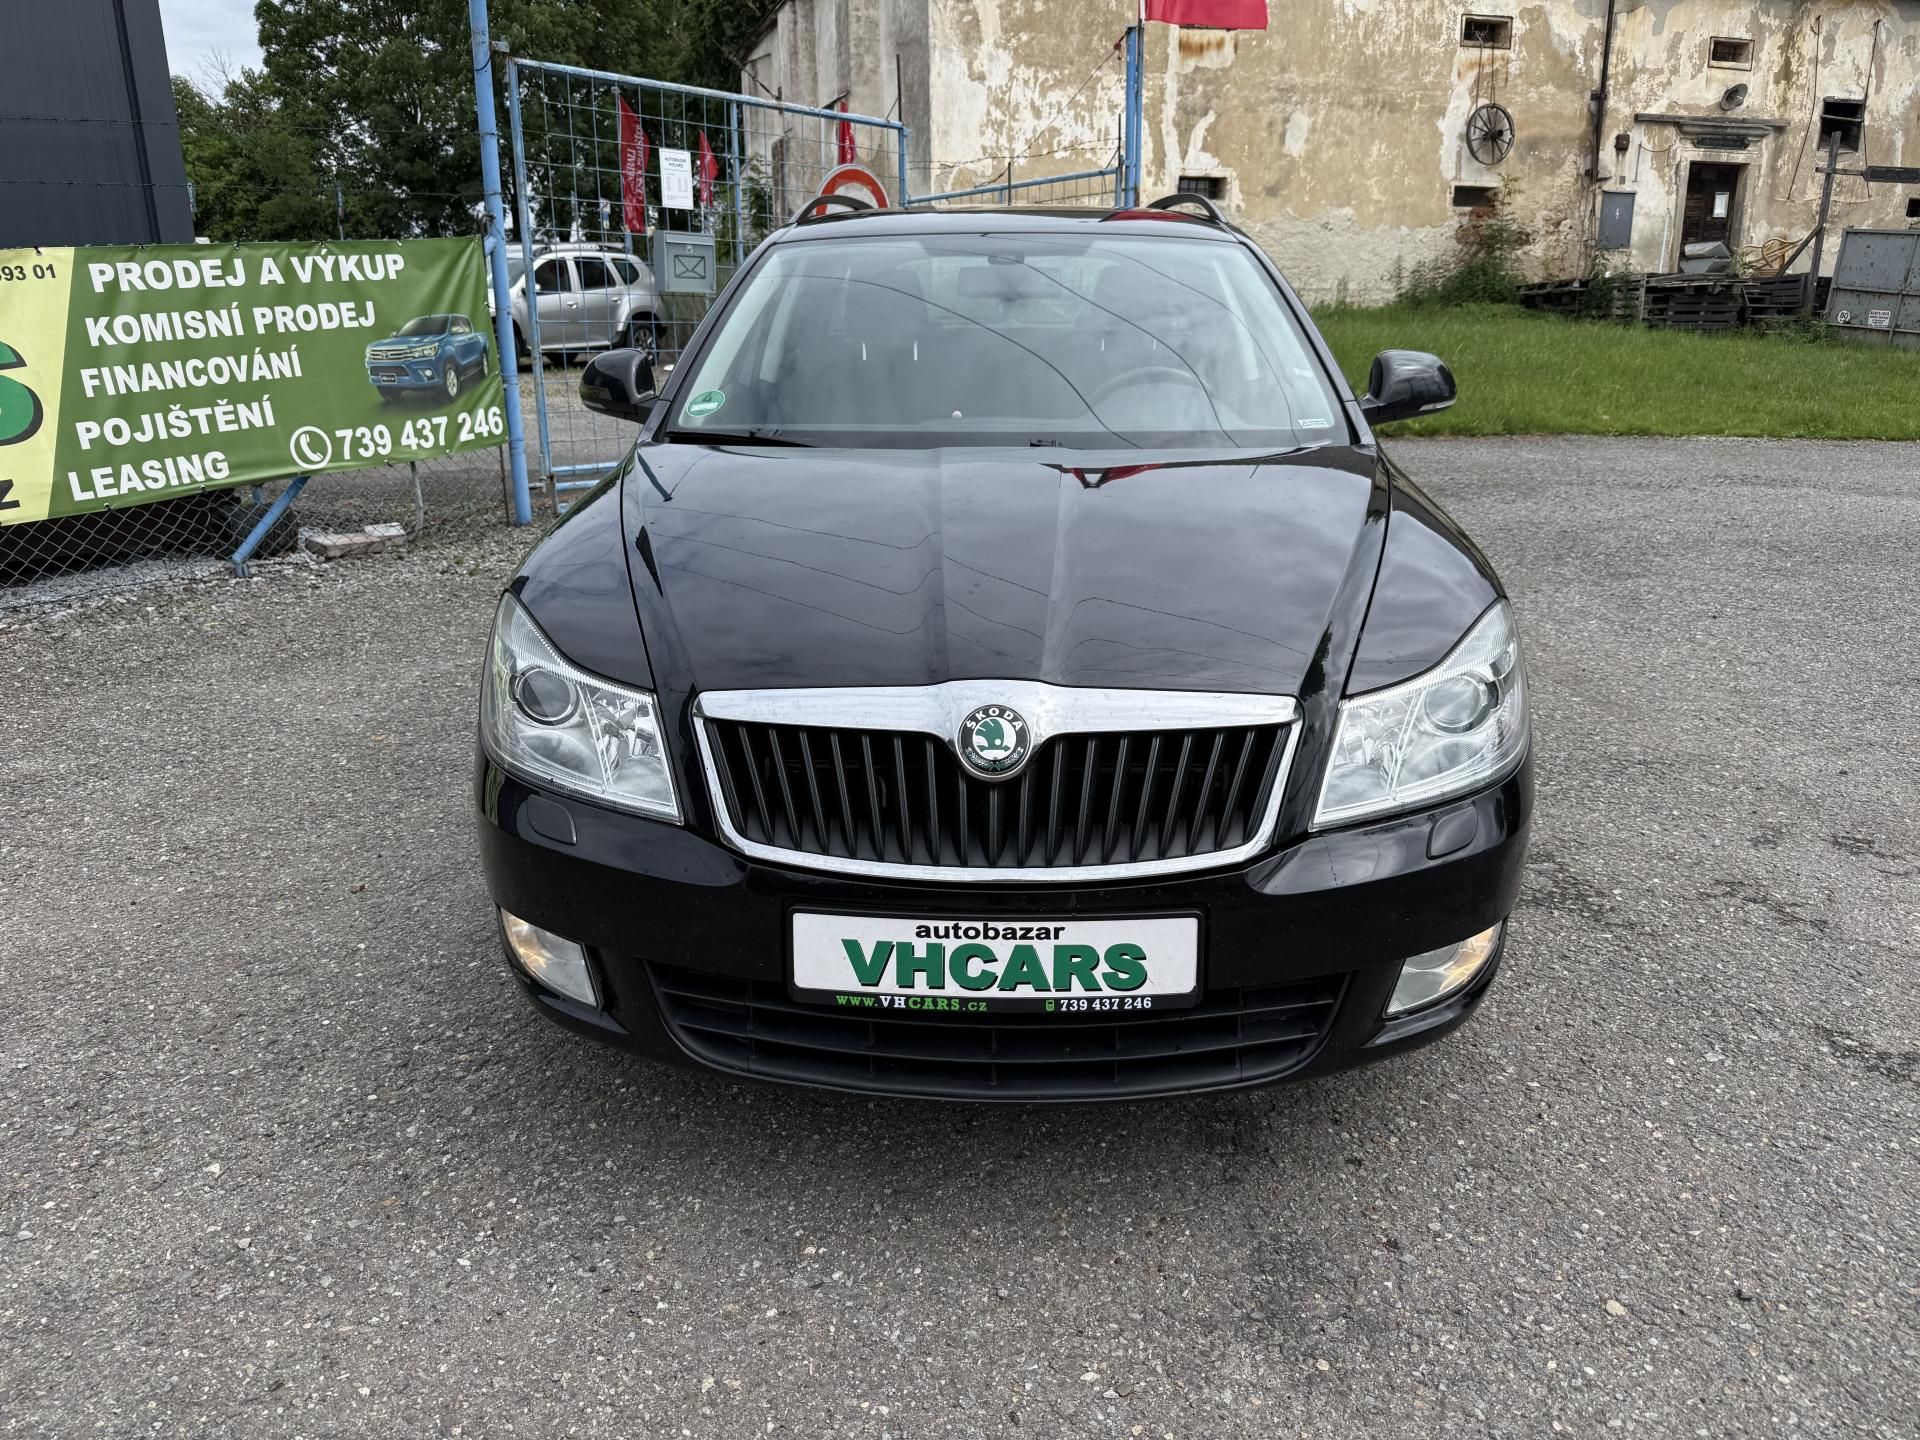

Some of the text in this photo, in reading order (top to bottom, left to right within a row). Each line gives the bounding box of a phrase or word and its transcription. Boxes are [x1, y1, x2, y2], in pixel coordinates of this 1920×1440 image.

[0, 263, 56, 281] 93 01
[88, 248, 405, 293] PRODEJ A VÝKUP
[85, 301, 376, 347] KOMISNÍ PRODEJ
[80, 344, 303, 398] FINANCOVÁNÍ
[75, 394, 275, 450] POJIŠTĚNÍ
[335, 405, 504, 460] 739 437 246
[68, 451, 230, 502] LEASING
[915, 922, 1066, 941] autobazar
[840, 938, 1148, 992] VHCARS
[1060, 999, 1088, 1011] 739
[1091, 998, 1120, 1011] 437
[1124, 997, 1152, 1010] 246
